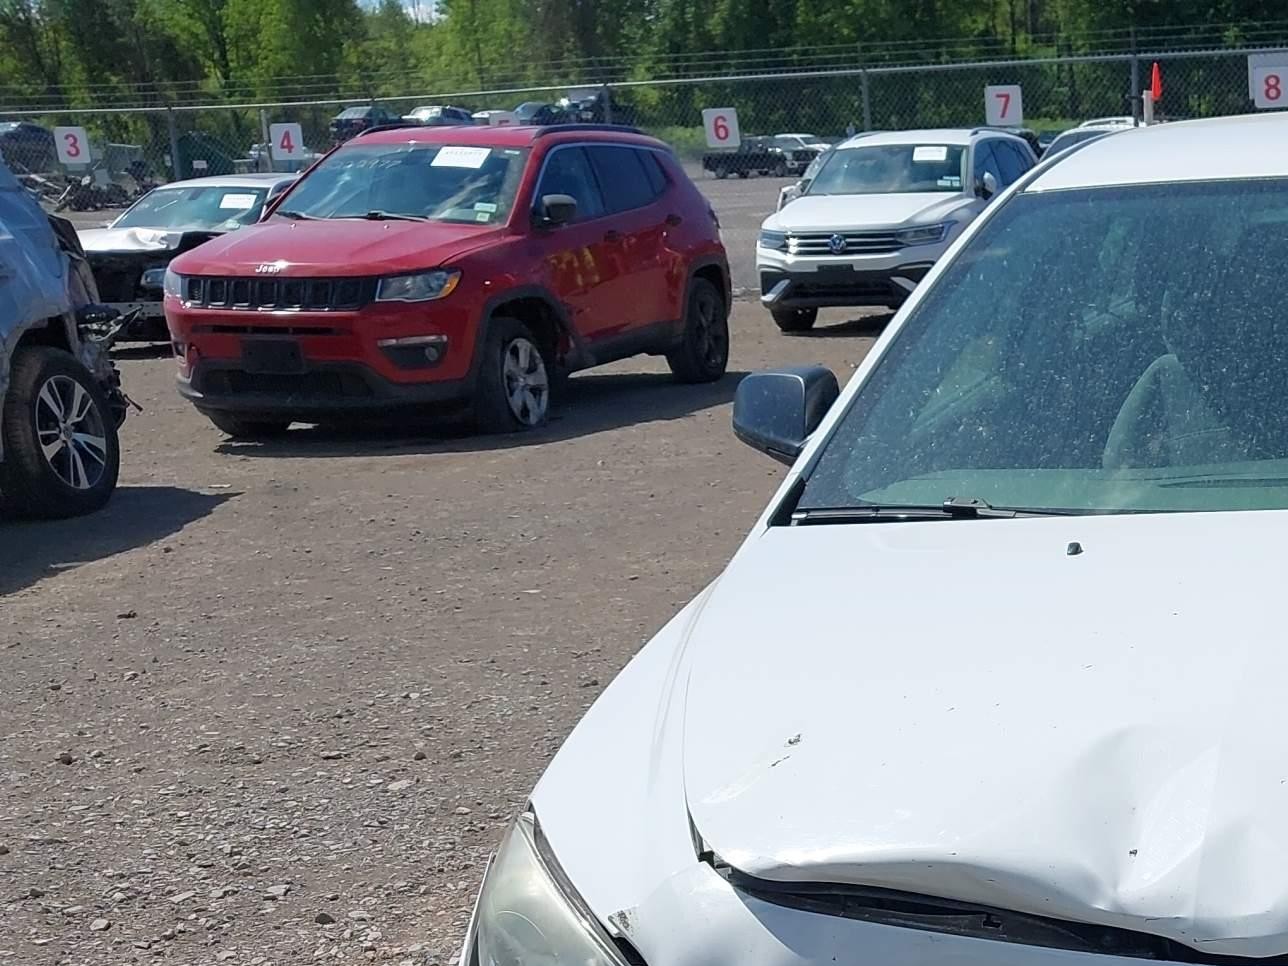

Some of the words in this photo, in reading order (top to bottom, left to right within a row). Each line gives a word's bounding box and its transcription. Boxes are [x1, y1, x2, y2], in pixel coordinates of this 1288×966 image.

[1264, 75, 1281, 100] 8
[995, 93, 1011, 118] 7
[713, 115, 730, 141] 6
[64, 133, 80, 158] 3
[281, 130, 295, 154] 4
